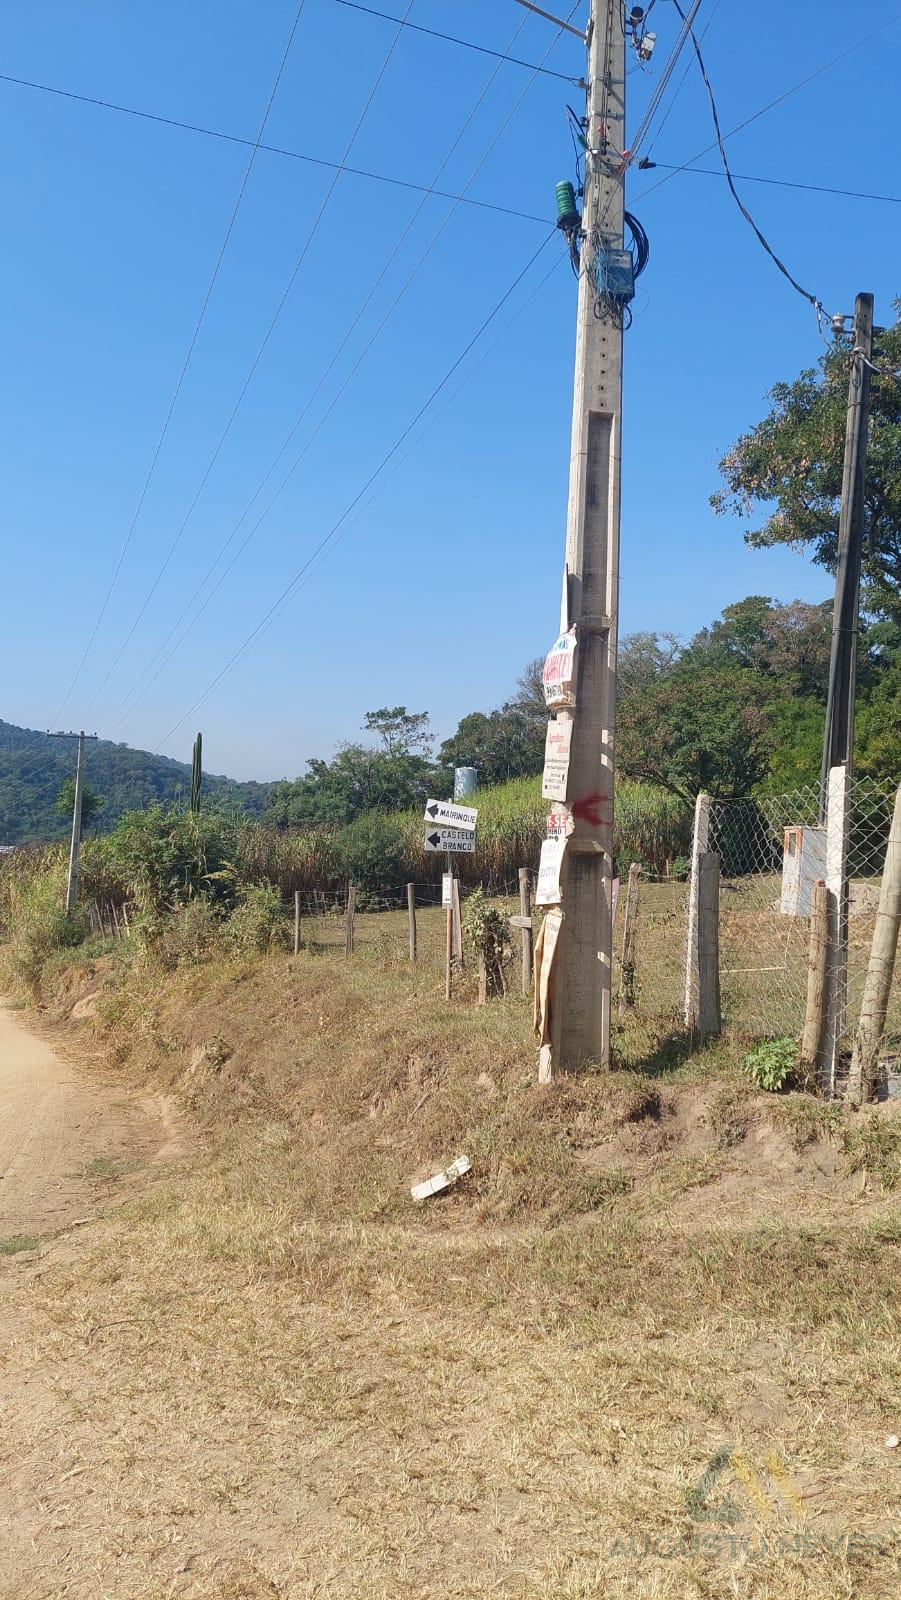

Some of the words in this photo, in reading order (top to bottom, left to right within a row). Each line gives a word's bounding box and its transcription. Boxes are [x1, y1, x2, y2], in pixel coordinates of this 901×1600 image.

[439, 809, 476, 823] MAIRINQUE
[441, 830, 475, 840] CASTELO
[442, 841, 472, 851] BRANCO
